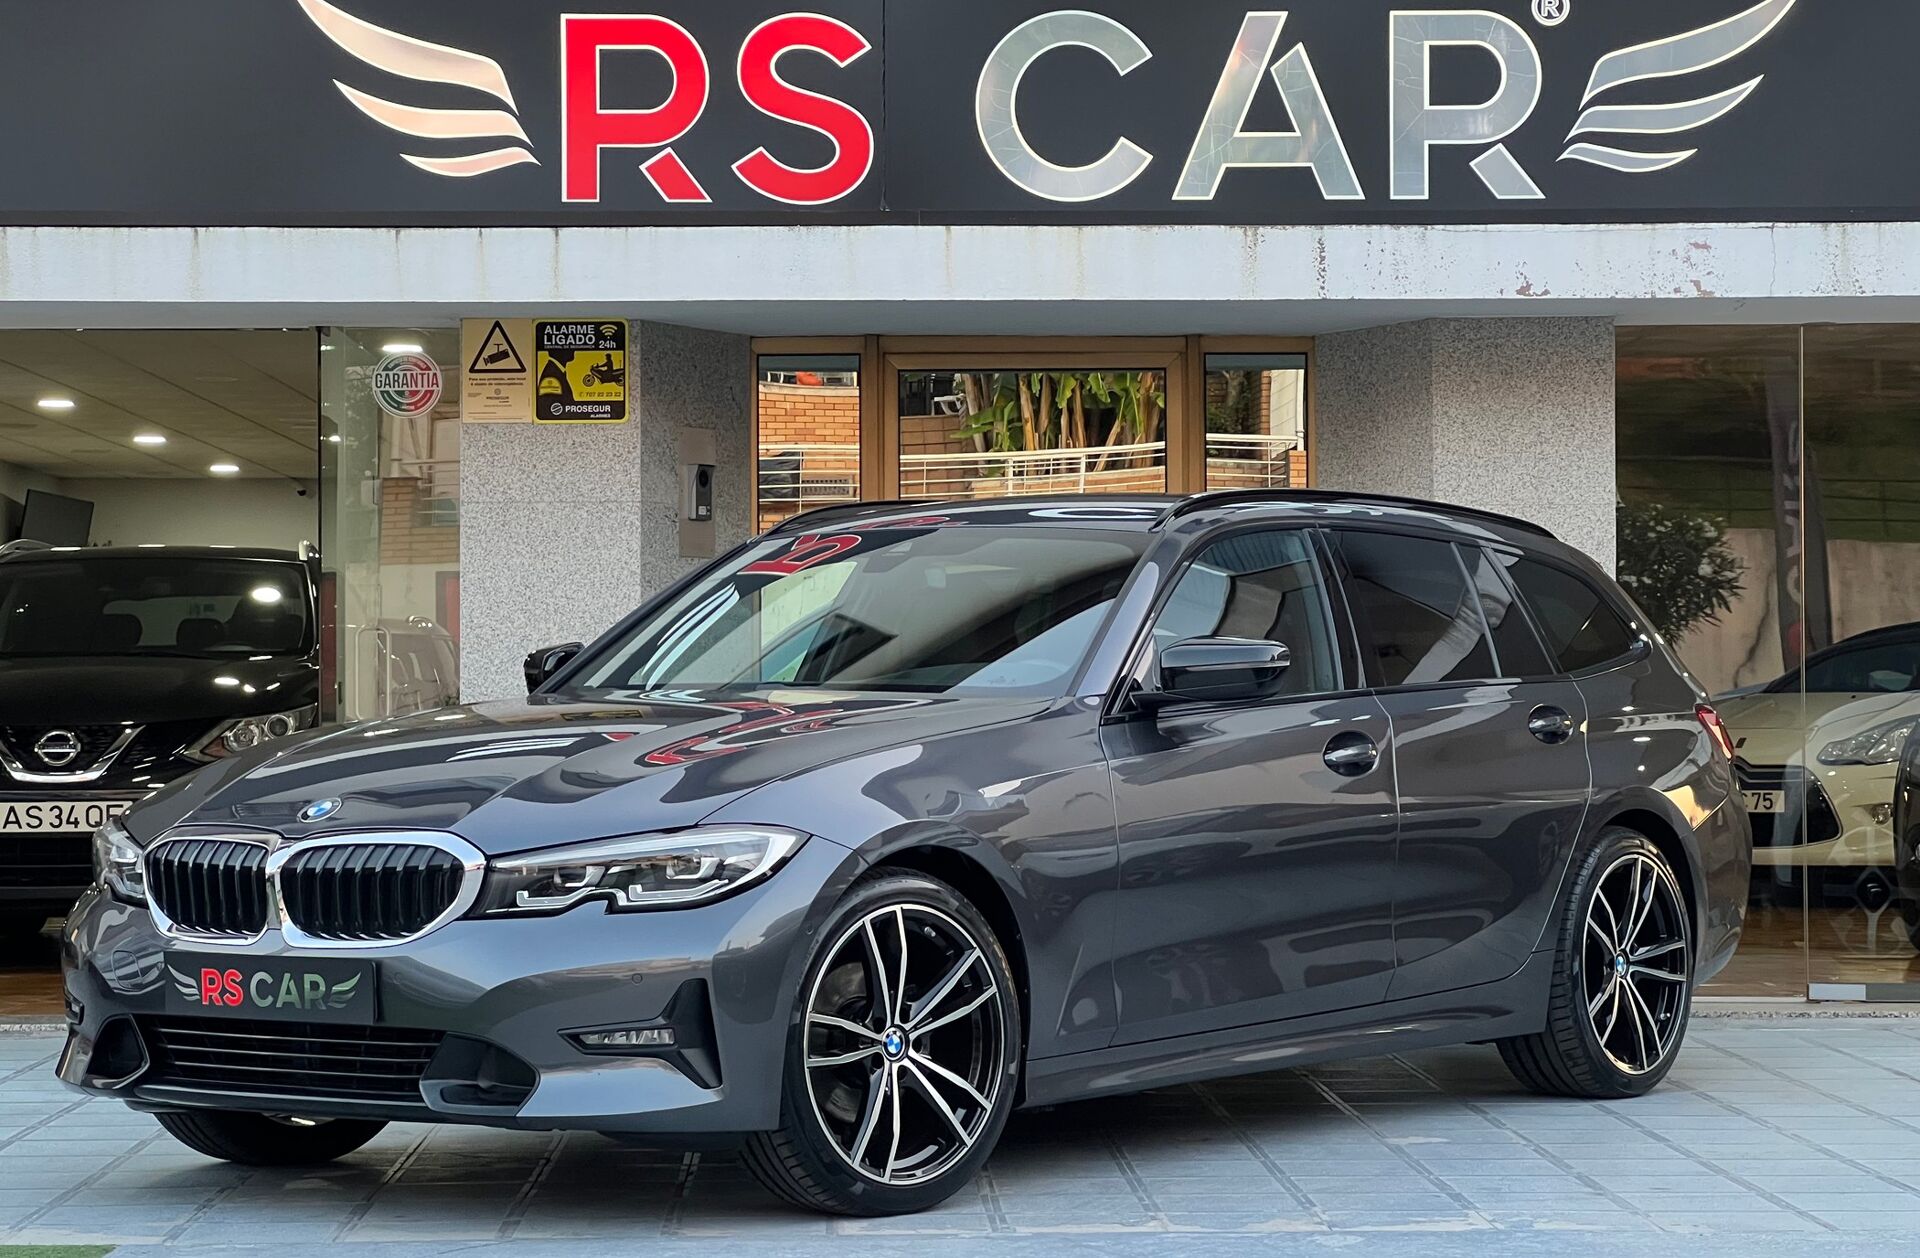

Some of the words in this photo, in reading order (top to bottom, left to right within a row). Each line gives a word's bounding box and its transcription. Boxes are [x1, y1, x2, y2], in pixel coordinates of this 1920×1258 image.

[559, 12, 875, 206] RS
[975, 9, 1546, 202] CAR
[544, 324, 595, 334] ALARME
[544, 334, 596, 345] LIGADO
[599, 340, 616, 349] 24h
[375, 372, 439, 389] GARANTIA
[565, 405, 611, 413] PROSEGUR
[1751, 792, 1774, 810] 75
[2, 805, 43, 829] AS
[49, 805, 80, 829] 34
[201, 968, 245, 1007] RS
[249, 971, 327, 1010] CAR
